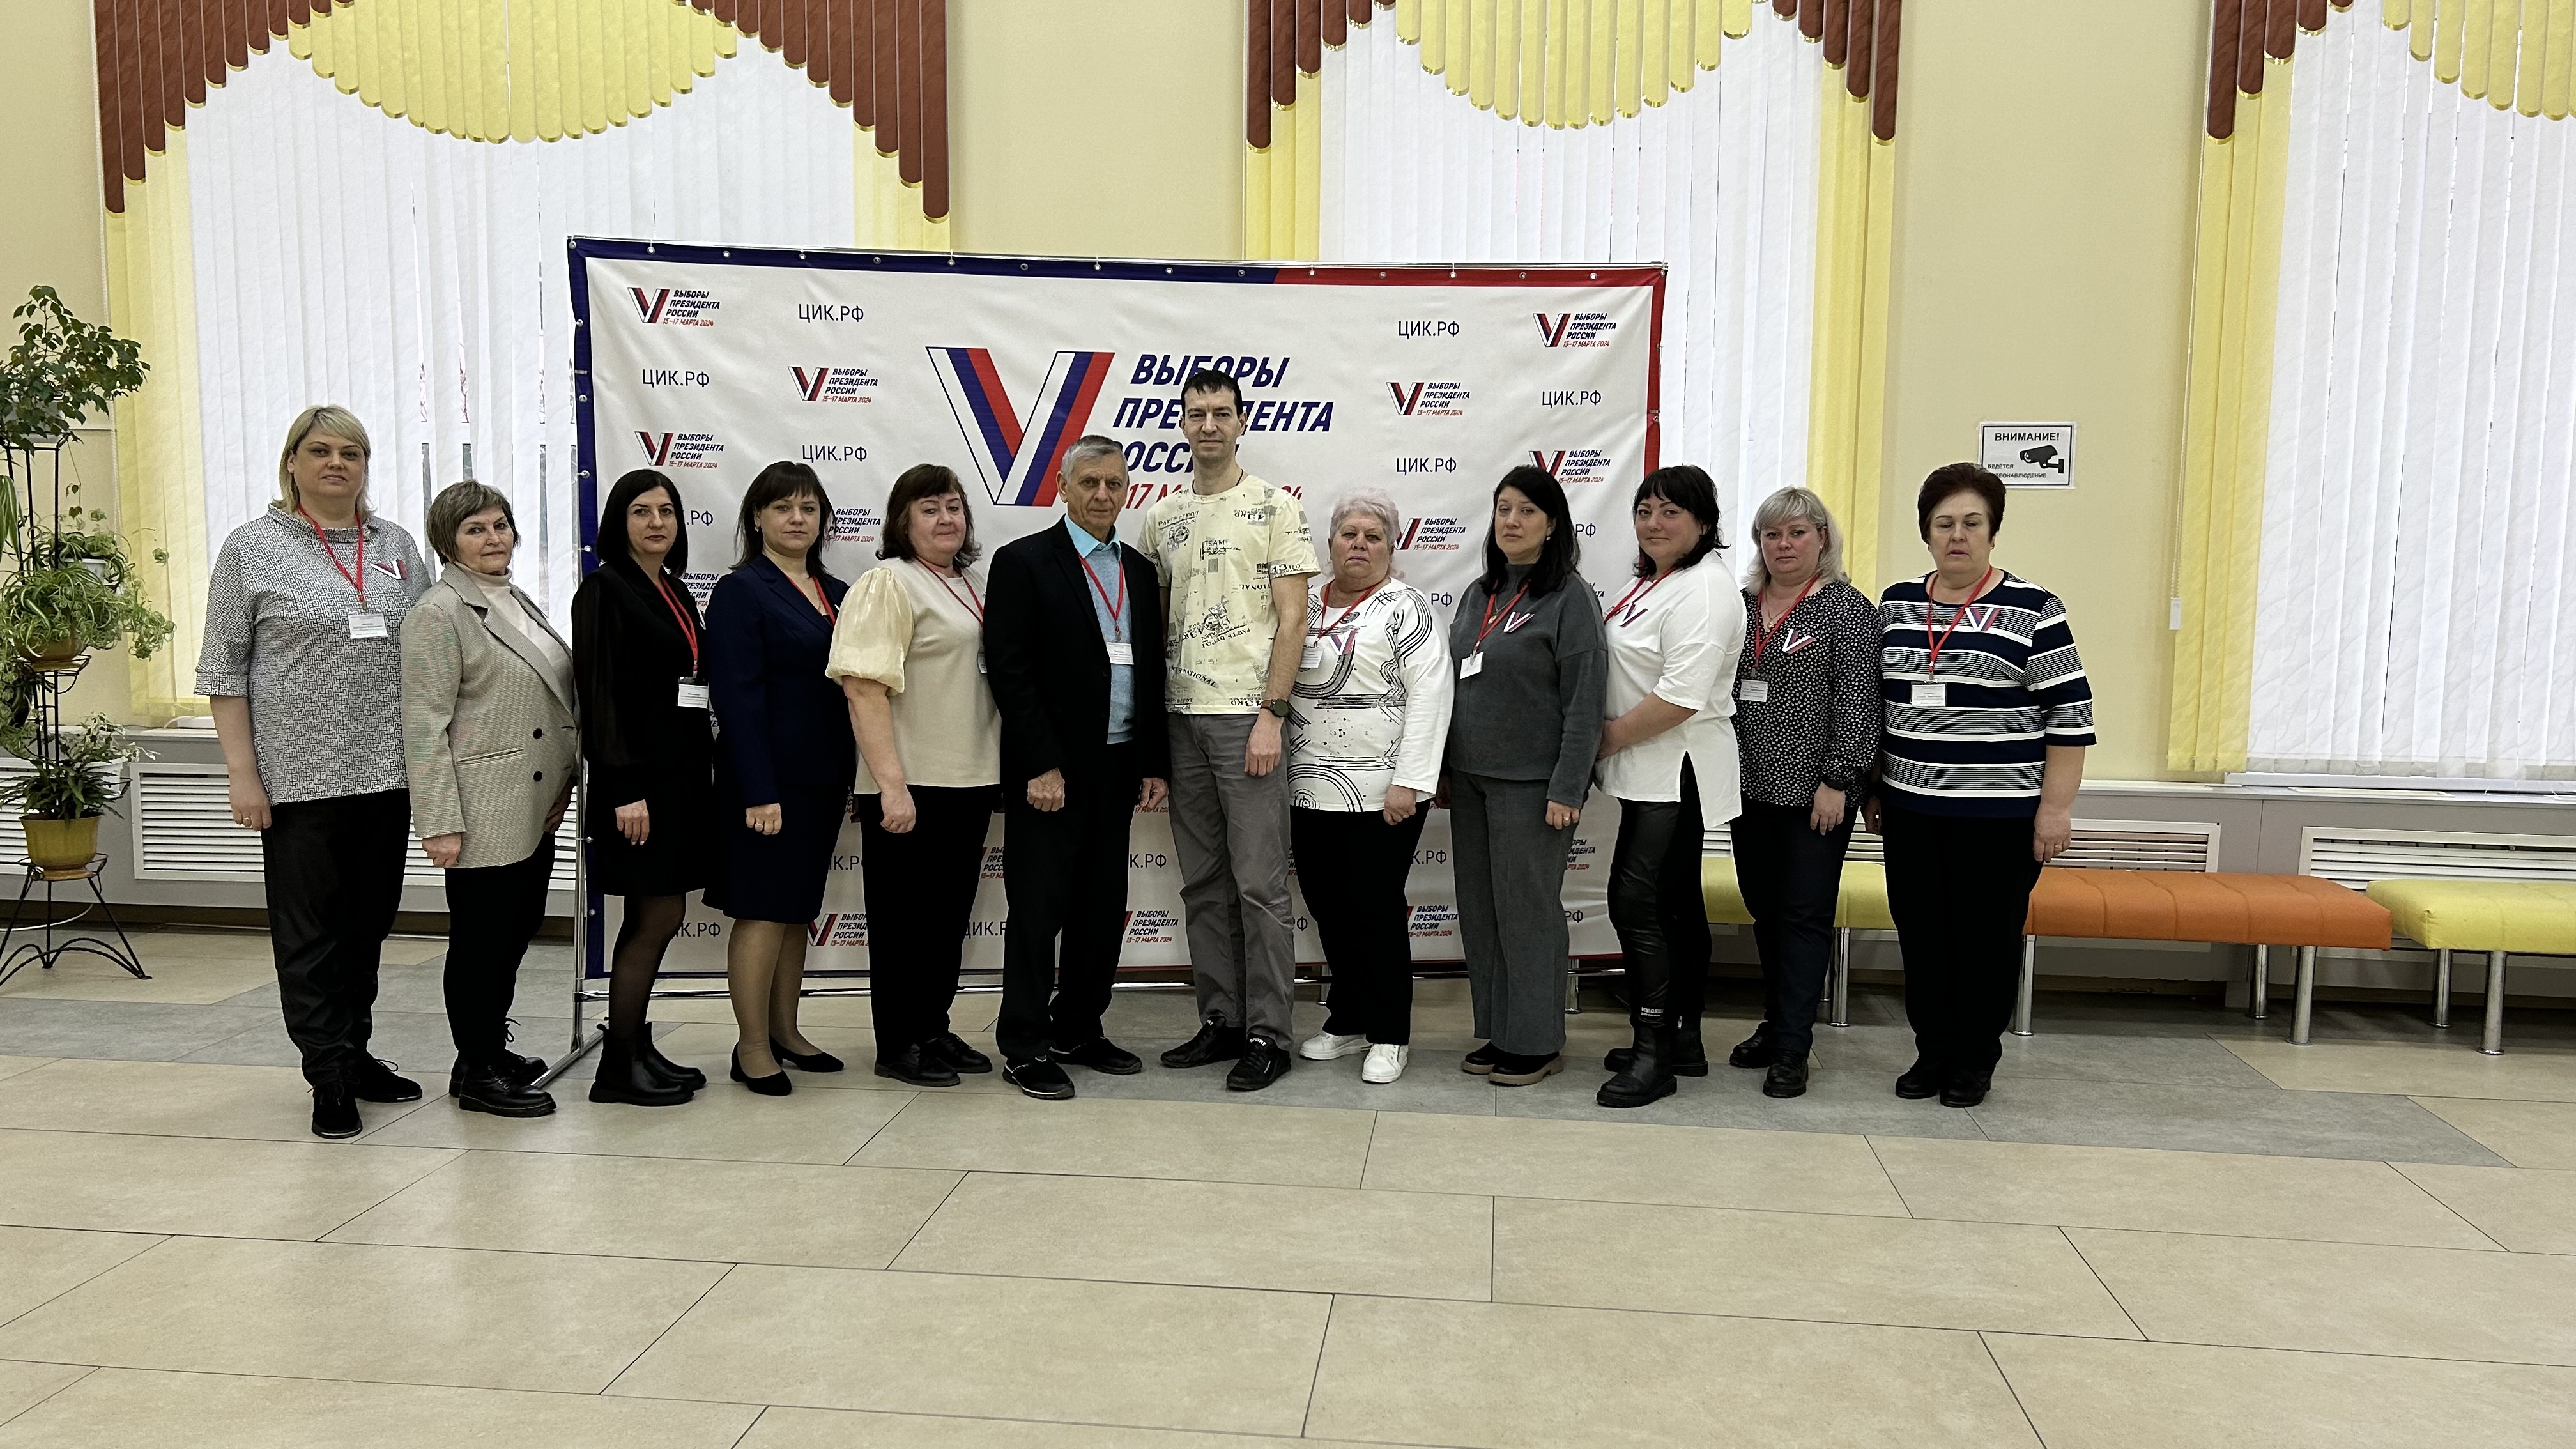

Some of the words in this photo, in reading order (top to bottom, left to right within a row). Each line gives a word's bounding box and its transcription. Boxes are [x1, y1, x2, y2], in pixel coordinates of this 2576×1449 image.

[673, 290, 709, 298] ВЫБОРЫ
[670, 300, 720, 309] ПРЕЗИДЕНТА
[666, 309, 699, 318] РОССИИ
[799, 304, 863, 323] ЦИК.РФ
[1399, 321, 1459, 339] ЦИК.РФ
[1570, 323, 1616, 331] ПРЕЗИДЕНТА
[643, 369, 709, 388] ЦИК.РФ
[829, 378, 878, 387] ПРЕЗИДЕНТА
[1542, 390, 1601, 408] ЦИК.РФ
[1112, 397, 1333, 432] ПРЕЕНТА
[1995, 433, 2059, 441] ВНИМАНИЕ!
[674, 443, 724, 452] ПРЕЗИДЕНТА
[802, 445, 867, 463] ЦИК.РФ
[1397, 457, 1456, 475] ЦИК.РФ
[687, 510, 713, 526] .РФ
[686, 582, 716, 591] РЕЗИДЕ
[1130, 854, 1167, 868] К.РФ
[1410, 850, 1448, 864] К.РФ
[830, 856, 862, 870] К.Р
[1133, 919, 1178, 927] ПРЕЗИДЕНТА
[1413, 914, 1459, 922] ПРЕЗИДЕНТА
[676, 922, 721, 937] К.РФ
[837, 922, 868, 931] ПРЕЗИД
[1250, 1038, 1267, 1046] SPORT
